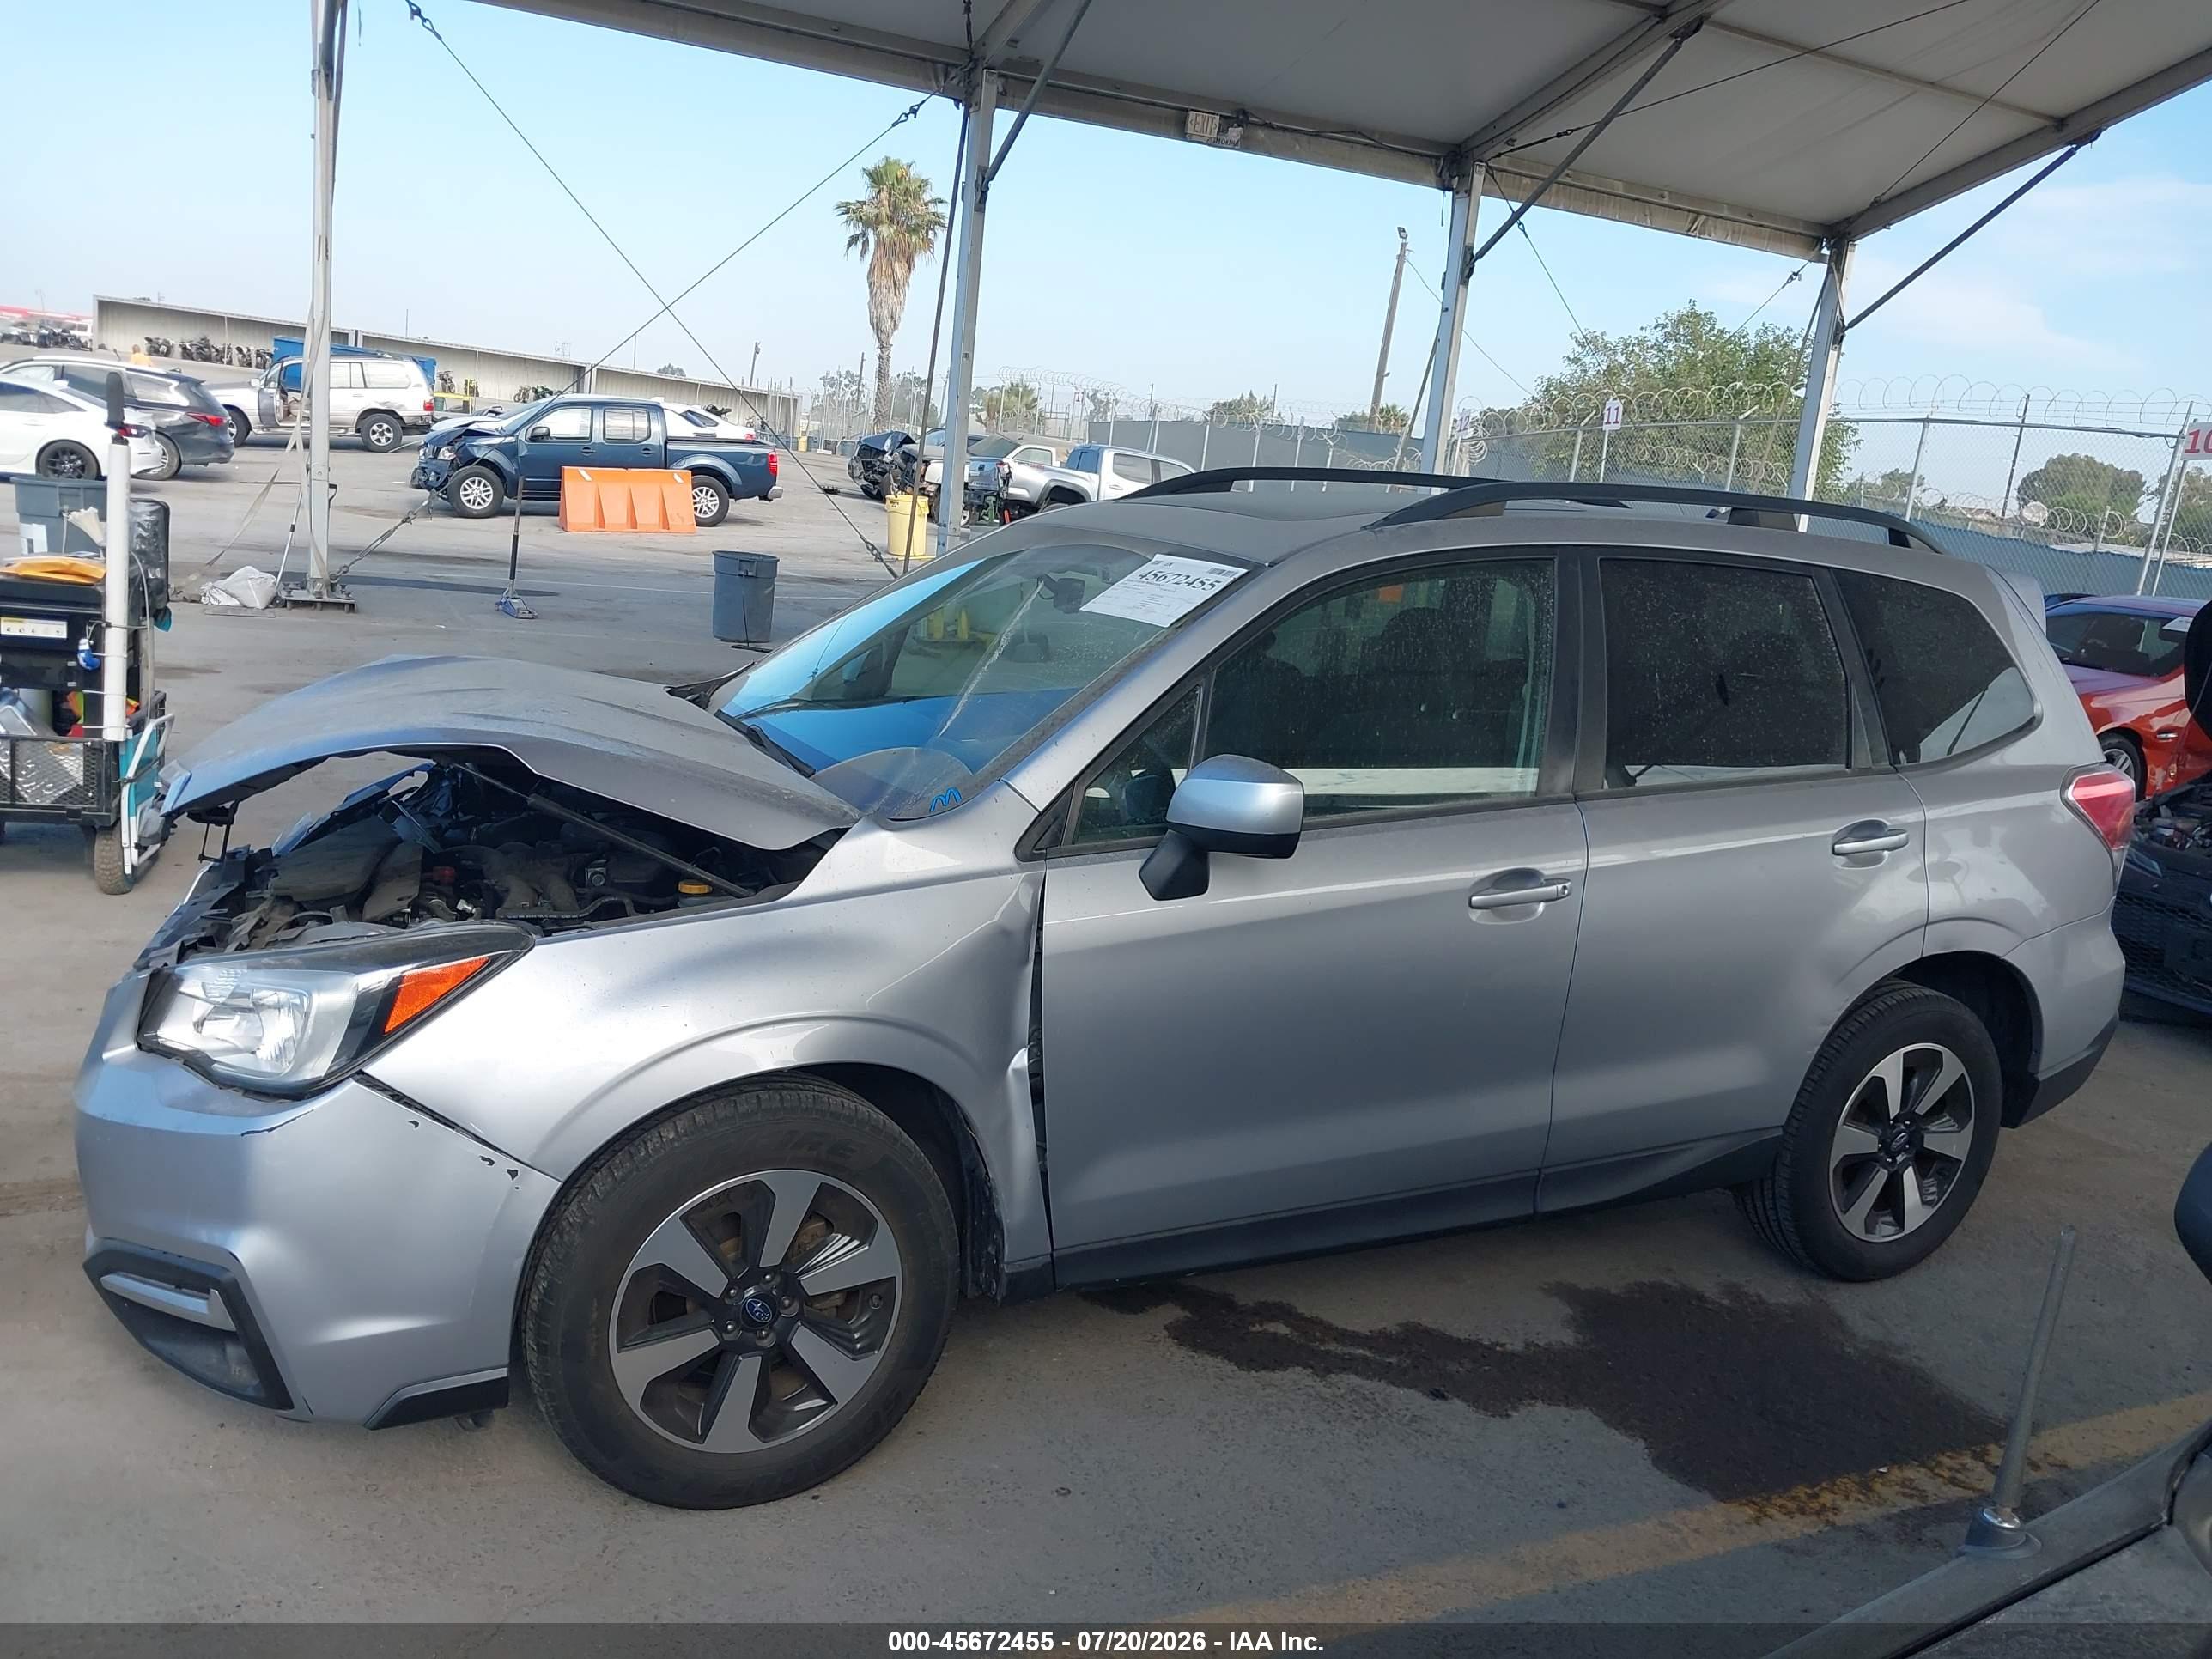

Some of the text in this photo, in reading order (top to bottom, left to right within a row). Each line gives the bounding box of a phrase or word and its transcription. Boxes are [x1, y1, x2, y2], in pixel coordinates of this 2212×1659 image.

[1194, 113, 1216, 136] EXIT
[1457, 415, 1470, 433] 12
[1605, 406, 1620, 425] 11
[1139, 569, 1223, 591] 45672455
